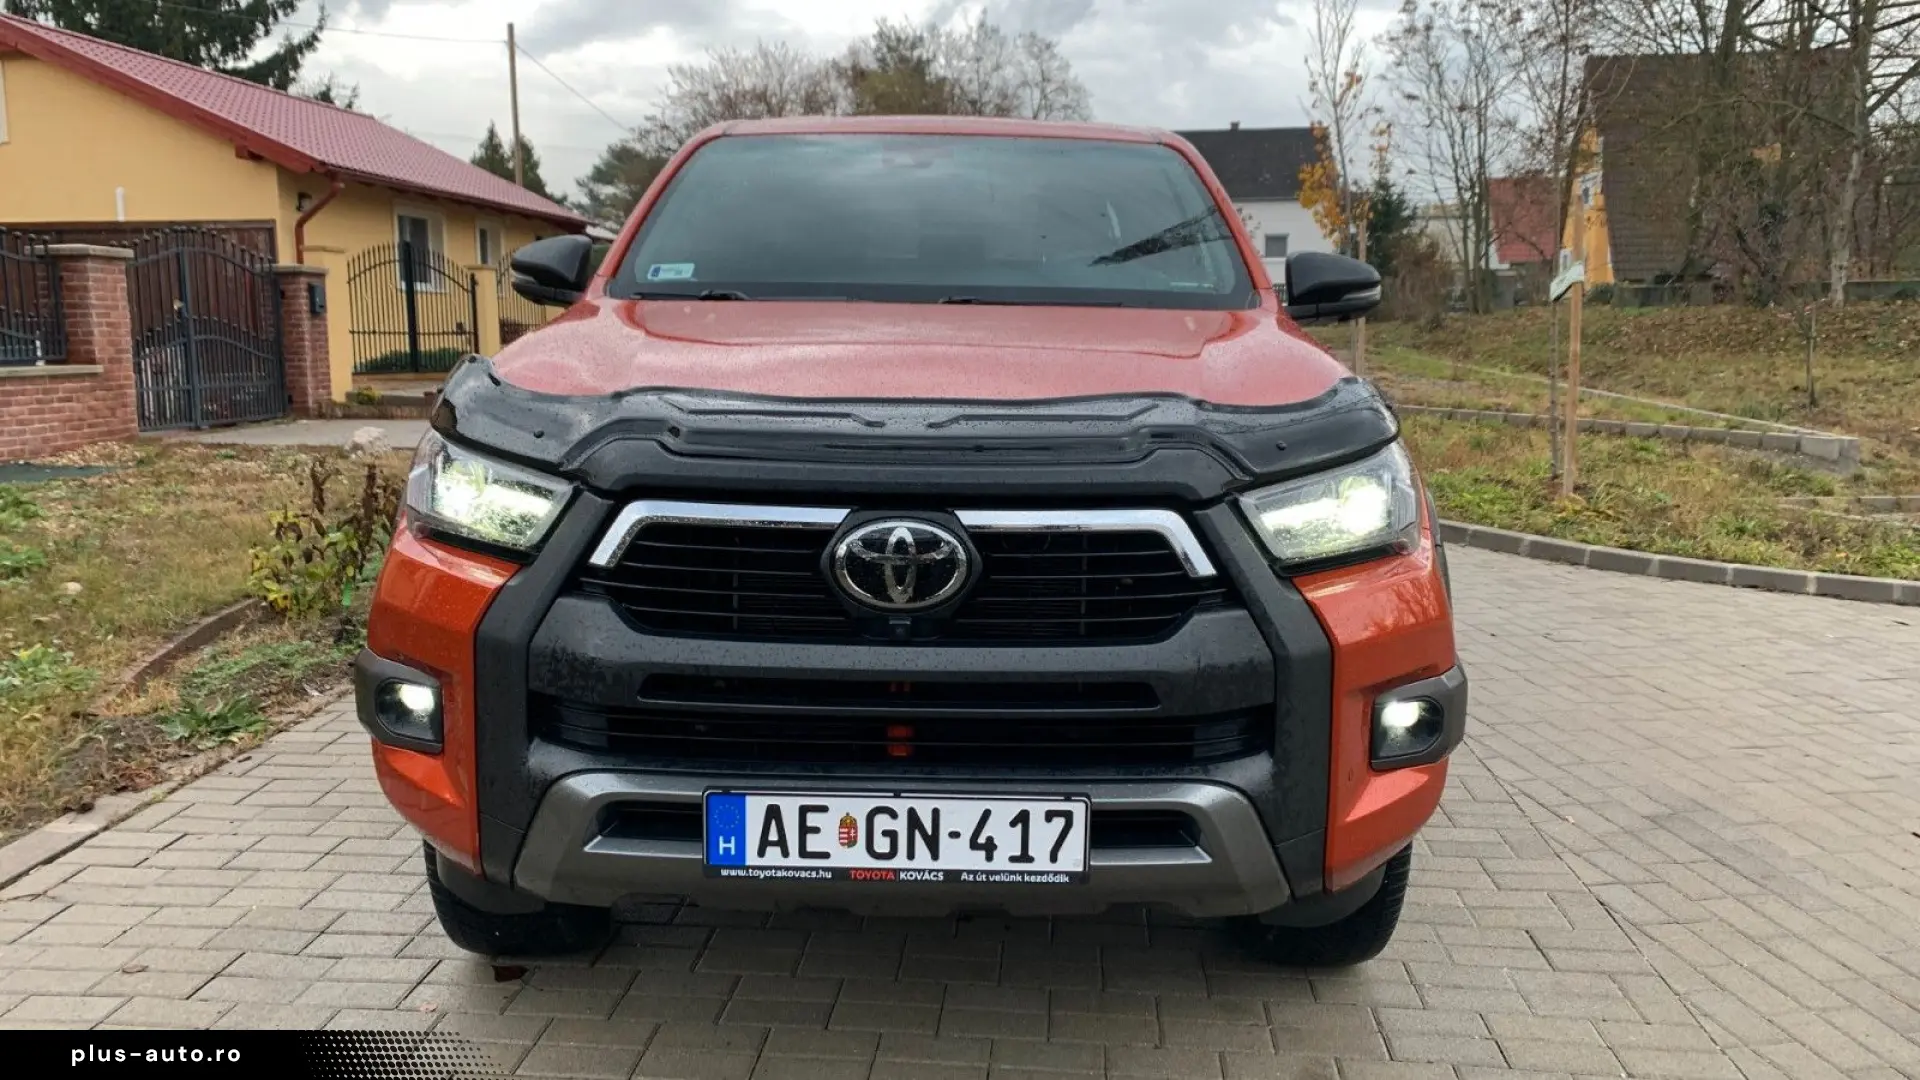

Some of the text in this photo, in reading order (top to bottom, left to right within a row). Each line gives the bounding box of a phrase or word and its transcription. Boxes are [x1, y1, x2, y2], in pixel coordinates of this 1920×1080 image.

[756, 803, 1075, 864] AE GN-417
[719, 836, 736, 856] H
[720, 868, 832, 879] www.toyotakovacs.hu
[850, 869, 944, 881] TOYOTA KOVÁCS
[960, 871, 1069, 883] Az út velünk kezdődik
